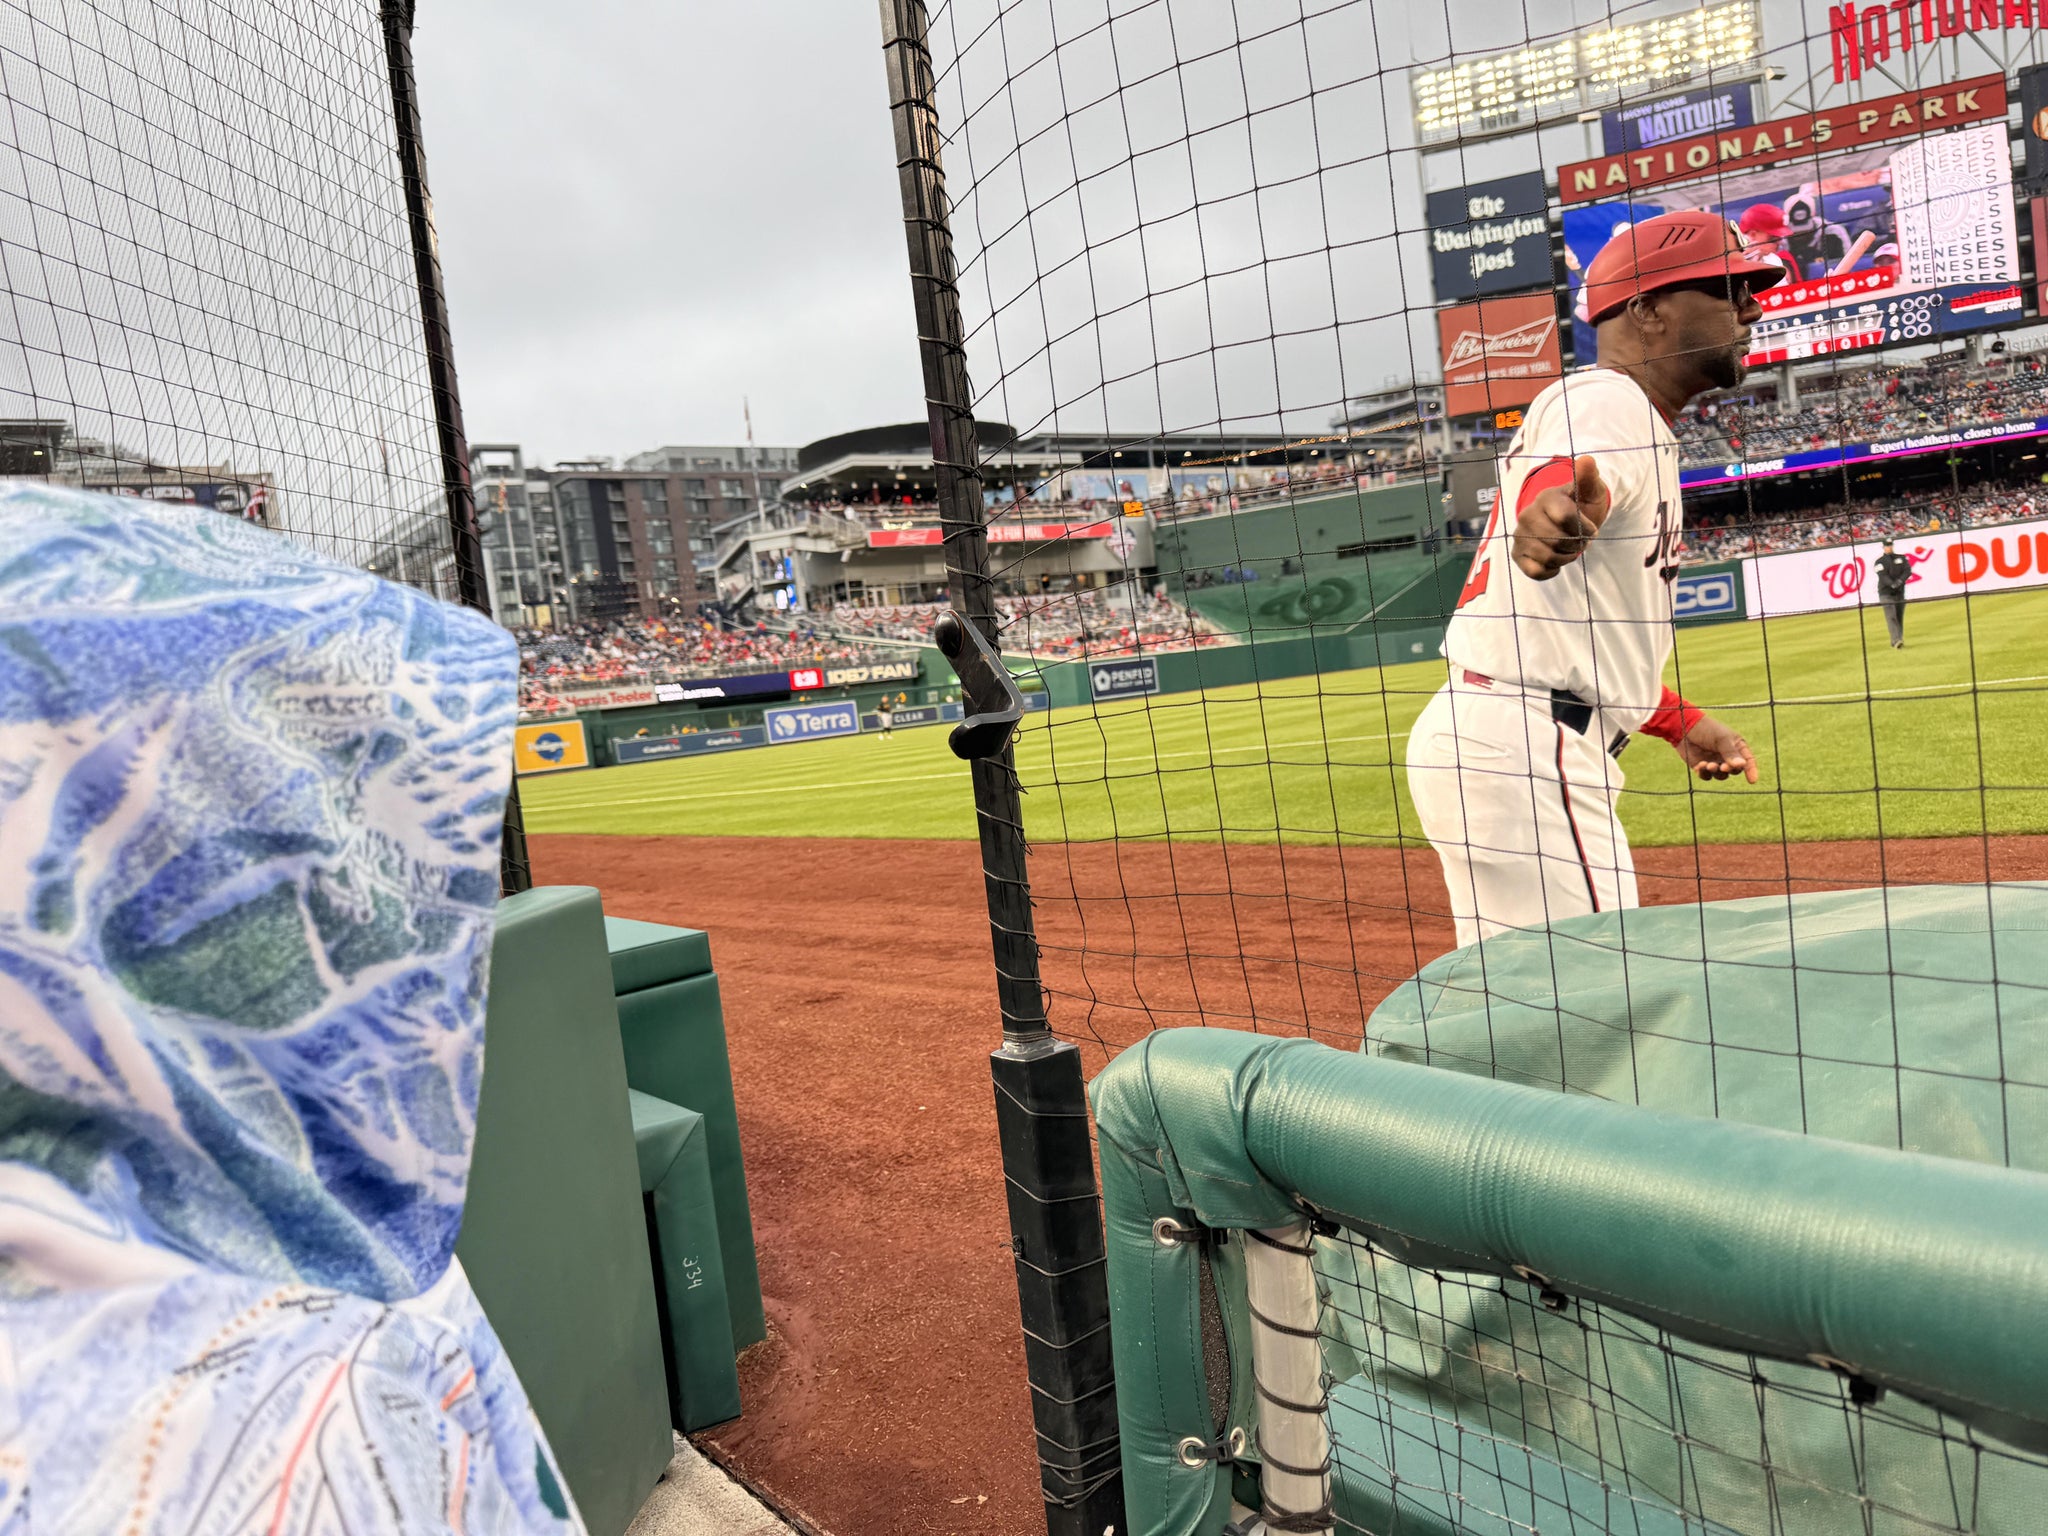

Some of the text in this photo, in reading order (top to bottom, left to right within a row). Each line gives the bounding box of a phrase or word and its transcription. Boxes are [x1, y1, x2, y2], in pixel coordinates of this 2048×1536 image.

[1829, 0, 2048, 84] NATIONA
[1617, 95, 1688, 122] SHOW SOME
[1637, 94, 1735, 145] NATITUDE
[1573, 118, 1832, 193] NATIONALS
[1858, 88, 1981, 134] PARK
[1468, 195, 1505, 218] The
[1433, 217, 1546, 252] Washington
[1470, 247, 1515, 279] Post
[1909, 238, 2005, 263] MENESES
[1910, 255, 2007, 275] MENESES
[1864, 318, 1875, 329] 2
[1451, 332, 1544, 359] Budweiser
[1840, 338, 1851, 350] 0
[1870, 421, 2036, 454] Expert healthcare, close to home
[1947, 532, 2048, 584] DU
[871, 662, 913, 680] FAN
[1111, 667, 1153, 681] PENFED
[796, 711, 852, 733] Terra
[894, 710, 924, 723] CLEAR
[682, 1255, 703, 1290] 334
